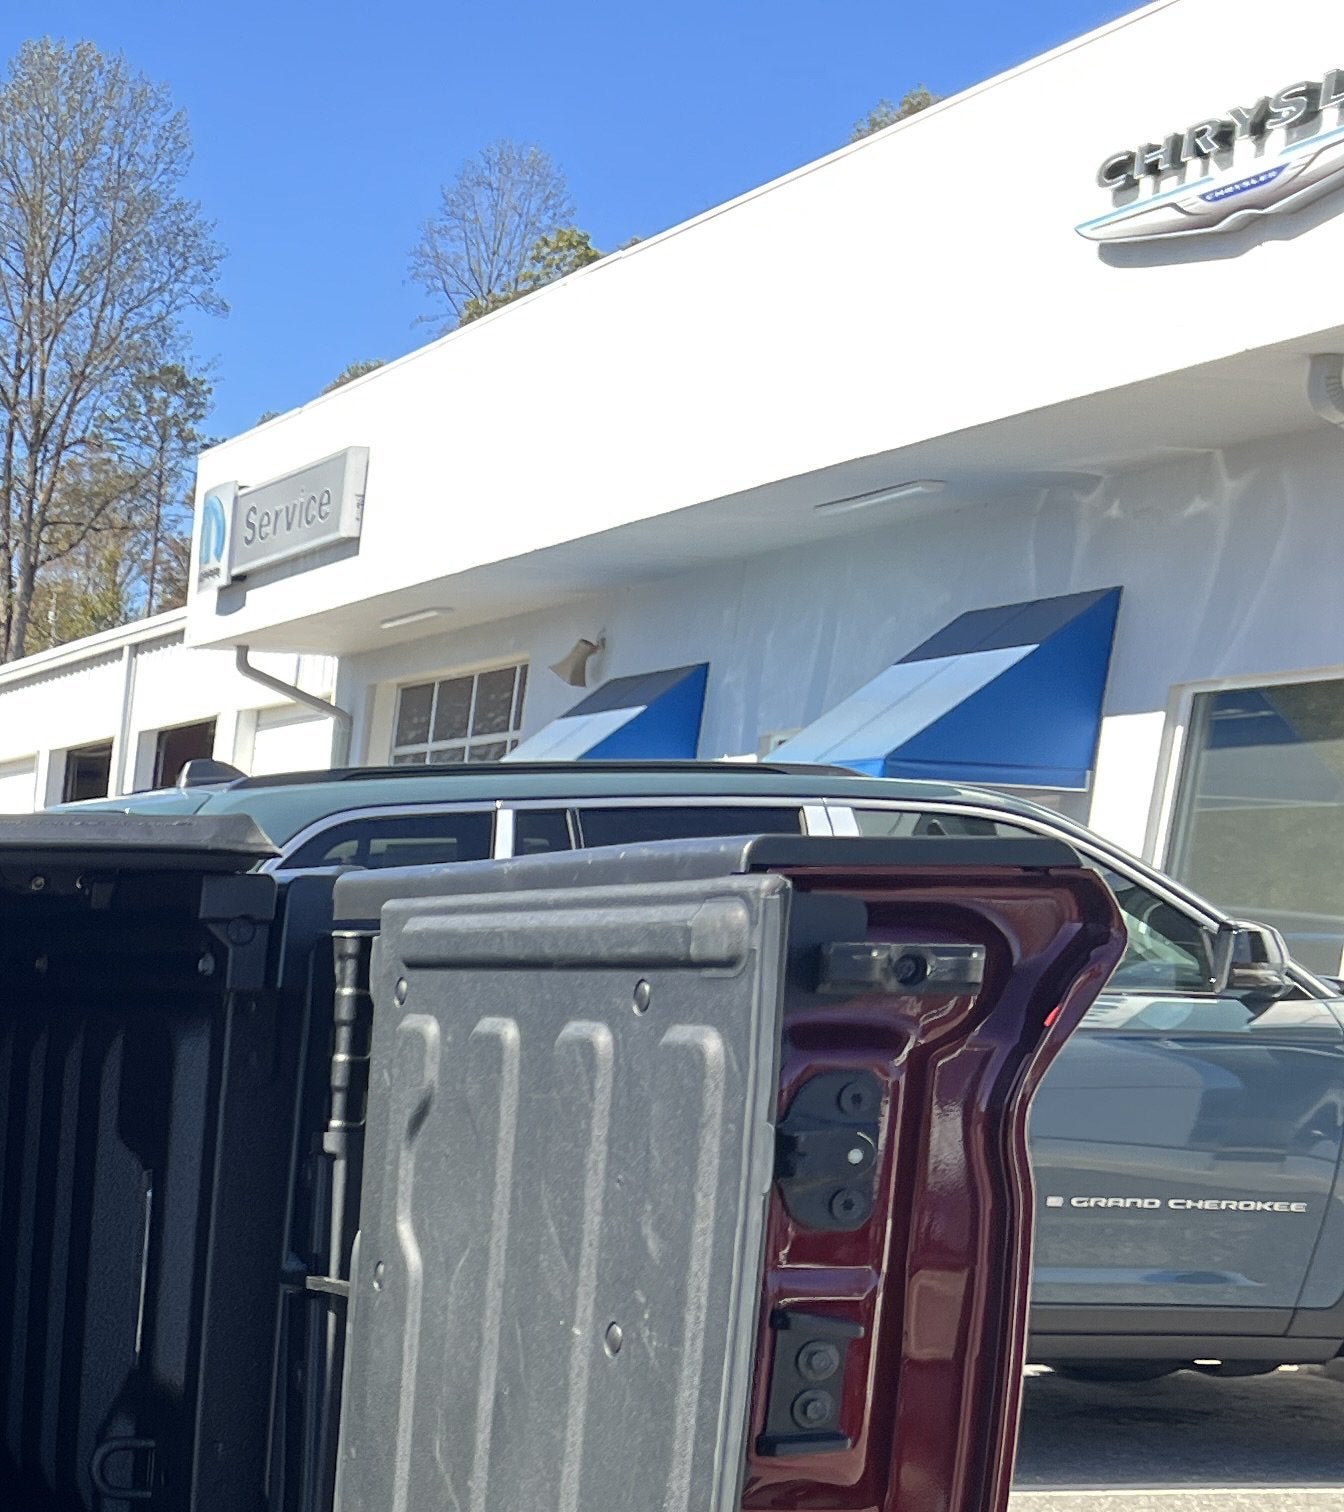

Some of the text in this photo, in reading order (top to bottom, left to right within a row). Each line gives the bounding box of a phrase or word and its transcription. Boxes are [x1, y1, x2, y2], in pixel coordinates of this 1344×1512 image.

[243, 488, 331, 546] Service
[1070, 1196, 1308, 1214] GRAND CHEROKEE
